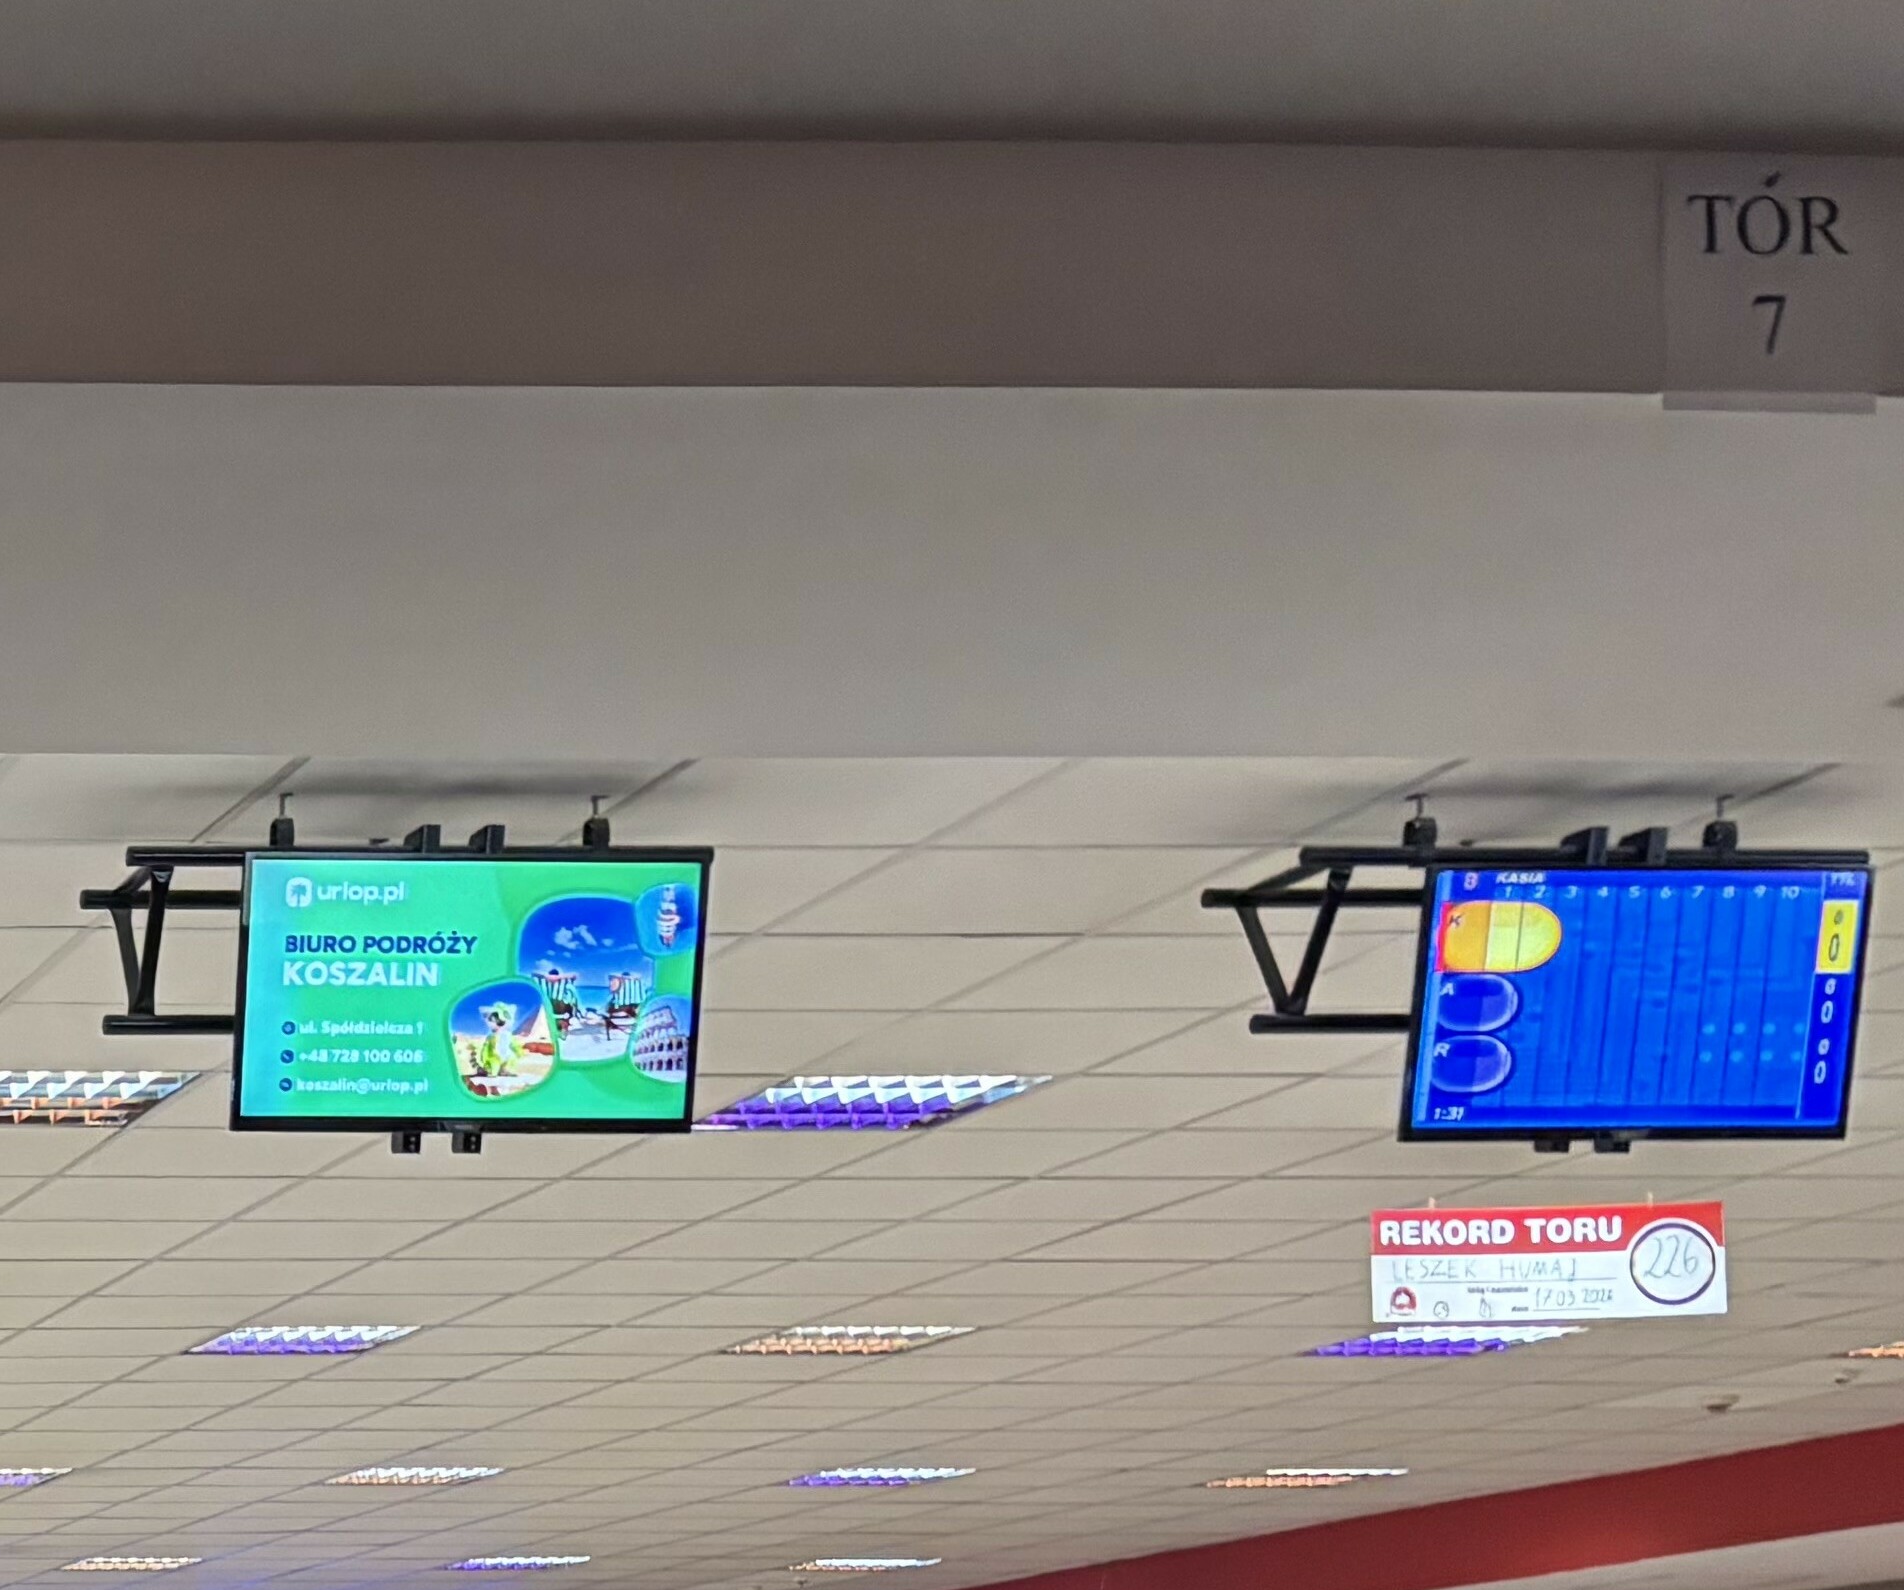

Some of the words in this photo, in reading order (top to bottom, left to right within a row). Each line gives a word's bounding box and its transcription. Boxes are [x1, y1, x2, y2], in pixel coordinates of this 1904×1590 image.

[1687, 171, 1849, 255] TÓR
[1752, 294, 1787, 355] 7
[1496, 872, 1545, 884] KASIA
[317, 880, 405, 906] urlop.pl
[1533, 886, 1545, 898] 2
[1566, 886, 1578, 898] 3
[1597, 886, 1609, 898] 4
[1629, 886, 1641, 898] 5
[1660, 886, 1672, 898] 6
[1781, 886, 1800, 898] 10
[285, 935, 357, 953] BIURO
[362, 930, 478, 954] PODRÓŻY
[1829, 934, 1839, 962] 0
[282, 961, 439, 987] KOSZALIN
[1440, 982, 1455, 996] A
[1821, 1000, 1833, 1023] 0
[299, 1020, 317, 1035] ul.
[321, 1020, 413, 1037] Spółdzielcza
[363, 1049, 391, 1062] 100
[1814, 1060, 1826, 1084] 0
[296, 1077, 428, 1095] koszalin@urlop.pl
[1380, 1219, 1515, 1246] REKORD
[1523, 1215, 1623, 1244] TORU
[1643, 1235, 1699, 1280] 226
[1392, 1260, 1477, 1281] LESZEK
